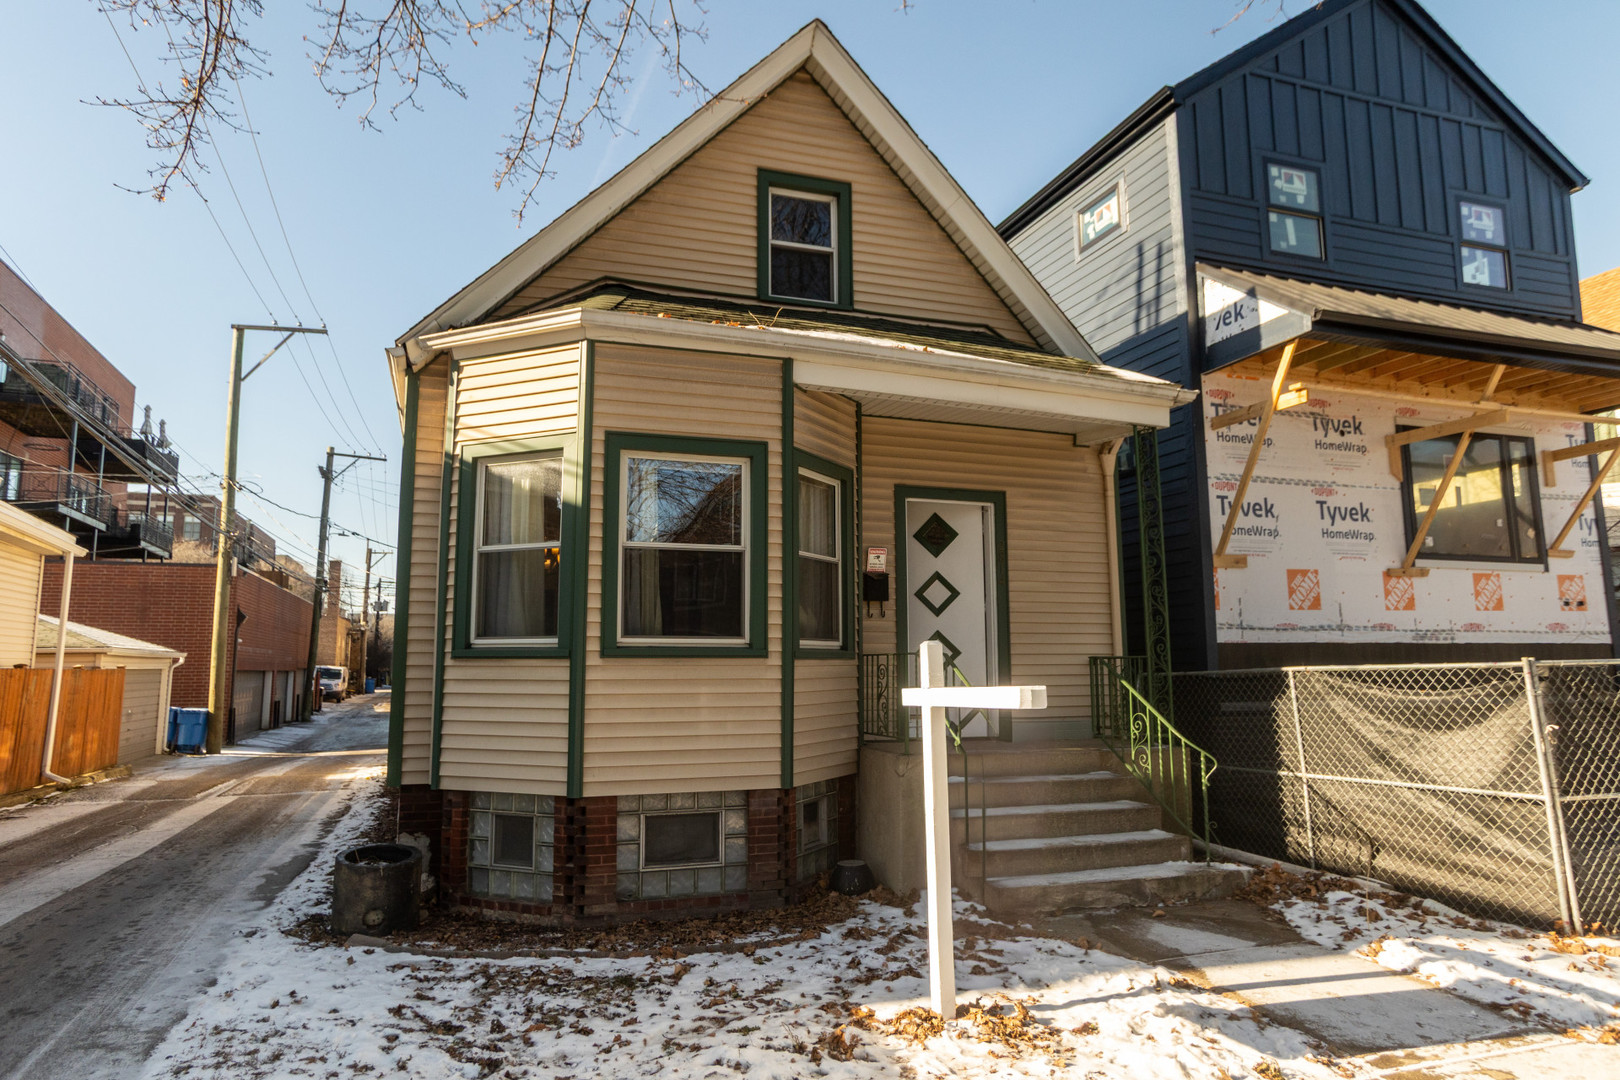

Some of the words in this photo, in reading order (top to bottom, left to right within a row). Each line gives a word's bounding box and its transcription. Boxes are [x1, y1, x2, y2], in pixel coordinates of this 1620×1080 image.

[1315, 440, 1367, 454] HomeWrap
[1315, 500, 1371, 526] Tyvek
[1222, 524, 1280, 540] omeWrap
[1322, 528, 1375, 543] HomeWrap
[1289, 570, 1319, 609] HOME
